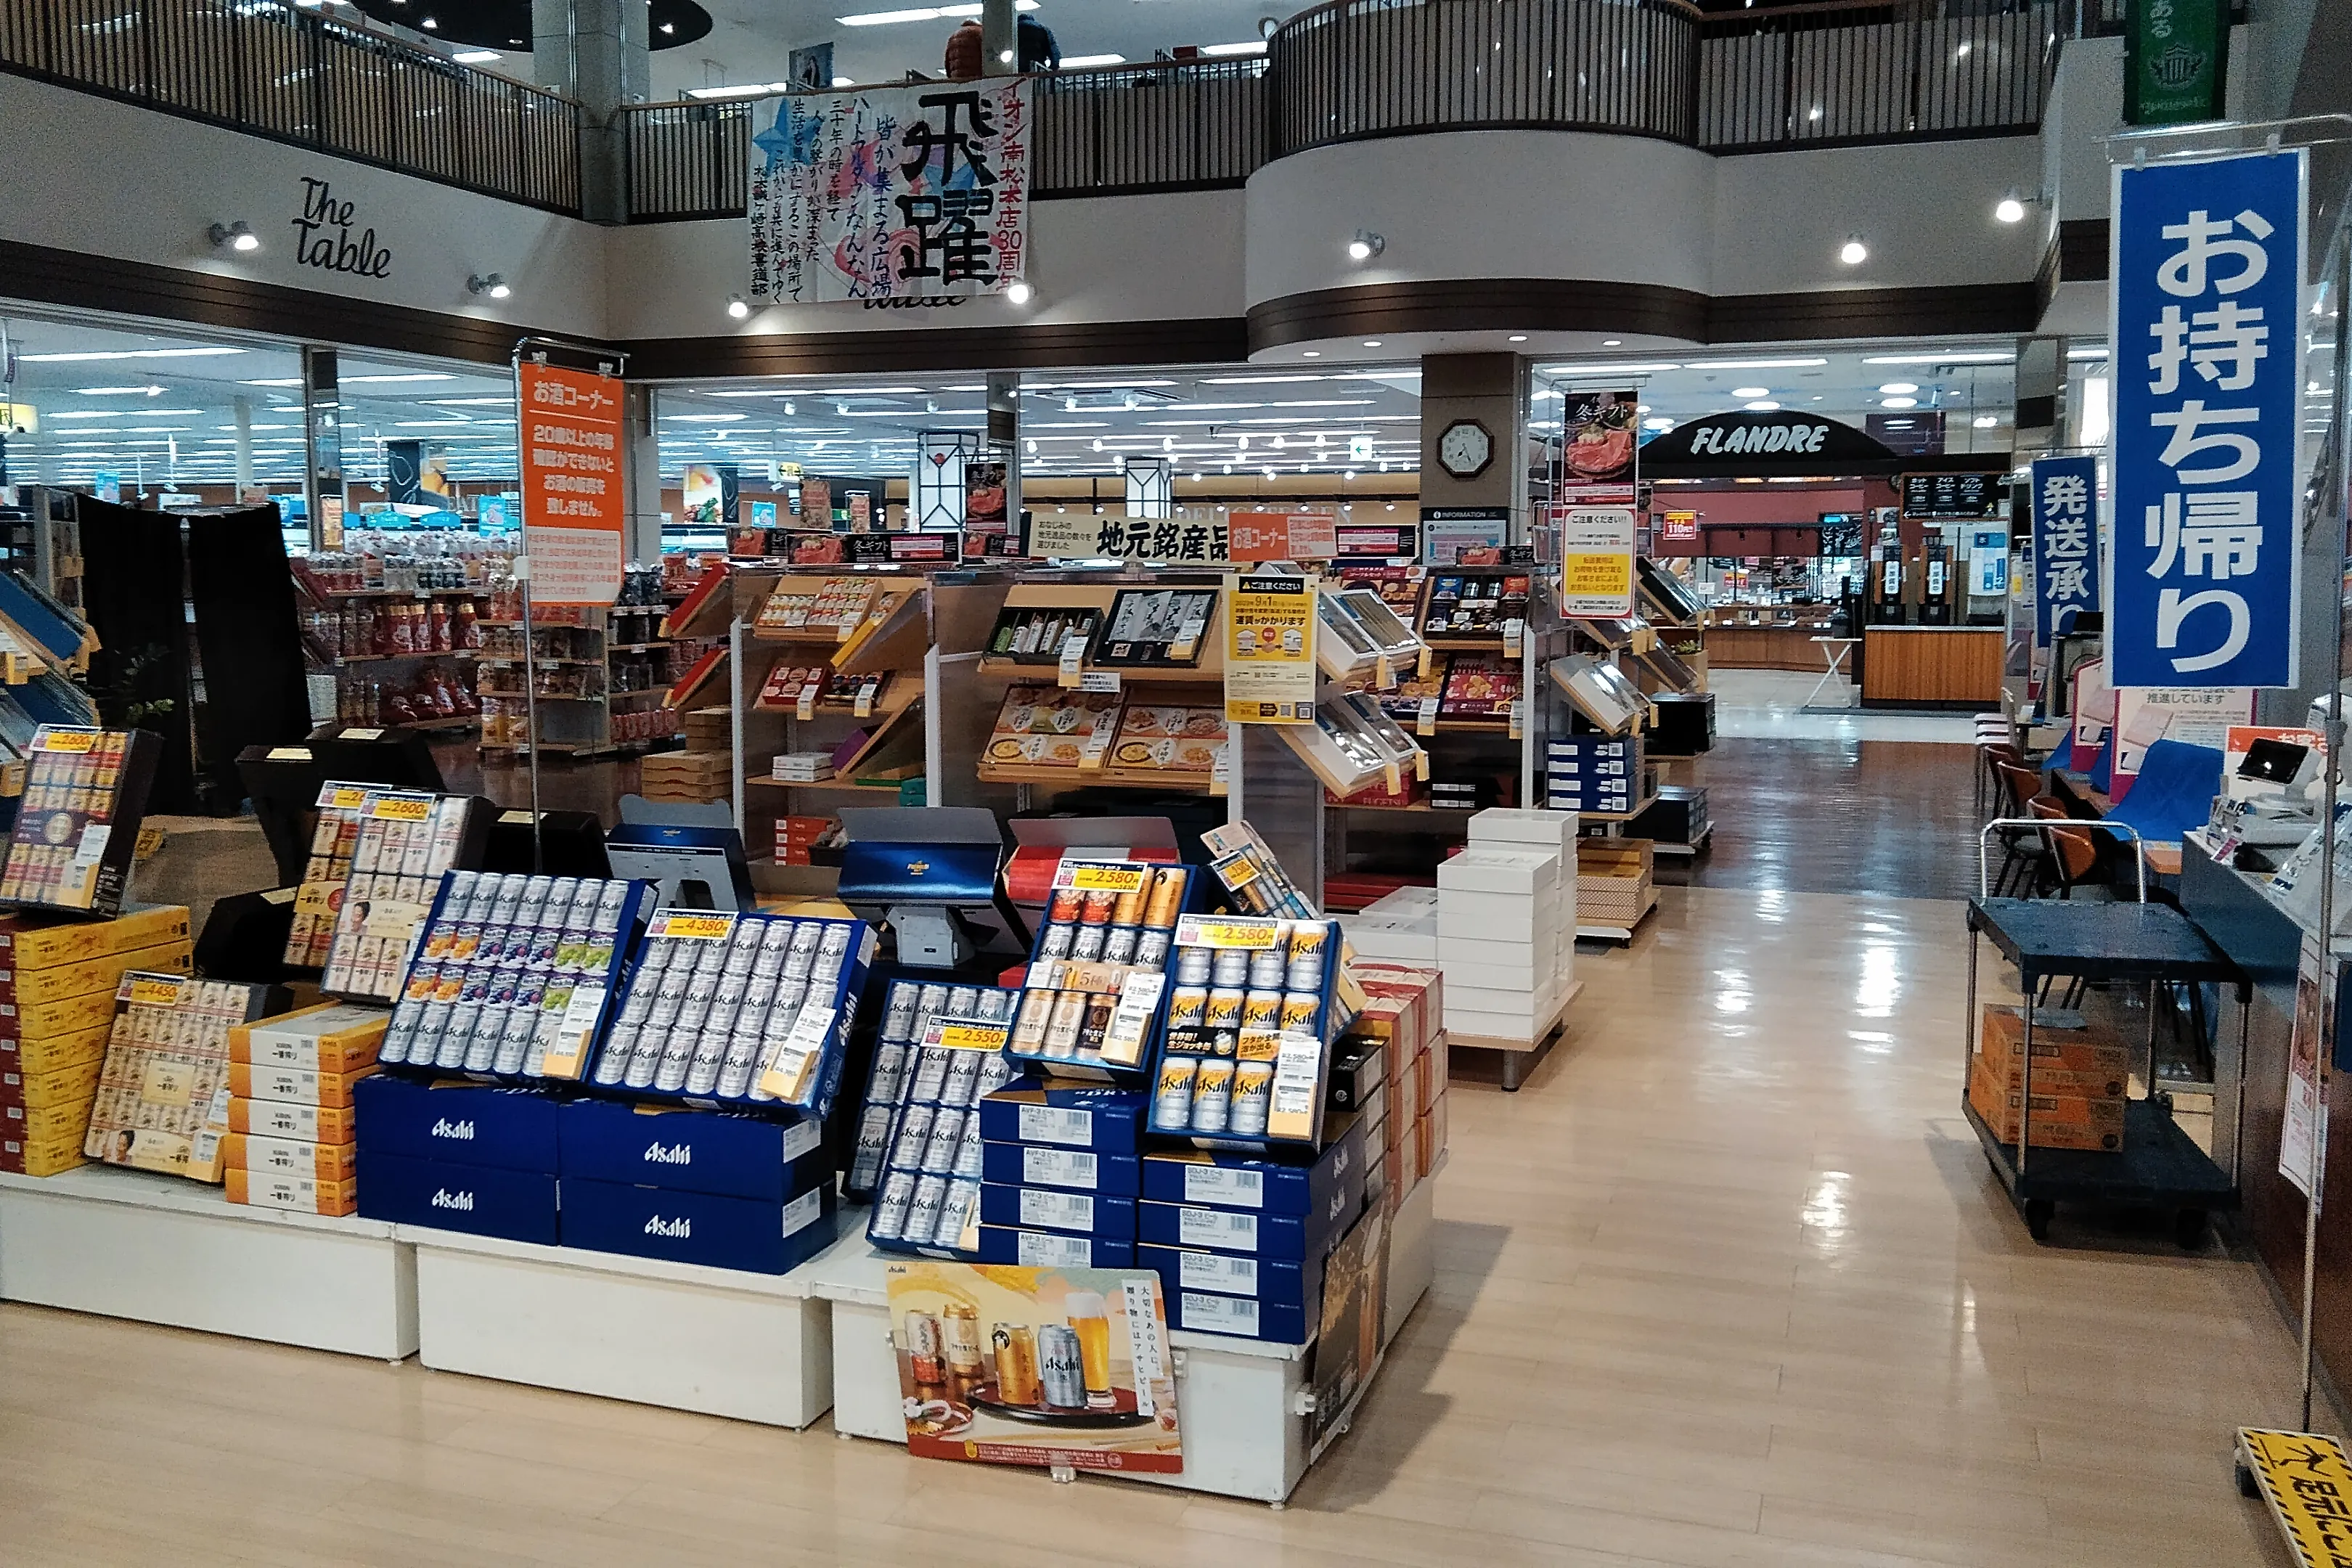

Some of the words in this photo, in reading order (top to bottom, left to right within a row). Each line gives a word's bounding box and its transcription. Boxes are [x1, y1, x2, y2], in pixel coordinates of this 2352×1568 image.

[895, 90, 999, 287] 飛躍
[301, 176, 354, 226] The
[291, 218, 391, 279] Table
[533, 380, 615, 410] お酒コーナー
[1575, 402, 1628, 421] 冬ギフト
[1690, 424, 1830, 455] FLANDRE
[2143, 209, 2276, 674] お持ち帰り
[852, 539, 889, 552] 冬ギフト
[1096, 520, 1228, 561] 地元銘産品
[1251, 581, 1302, 591] ご注意ください
[2147, 693, 2226, 705] 推進しています
[432, 1118, 474, 1140] Asahi
[645, 1142, 690, 1165] Asahi
[432, 1188, 473, 1211] Asahi
[645, 1215, 690, 1238] Asahi
[1141, 1286, 1160, 1371] 大切なあの人に、
[1045, 1355, 1080, 1372] Asahi
